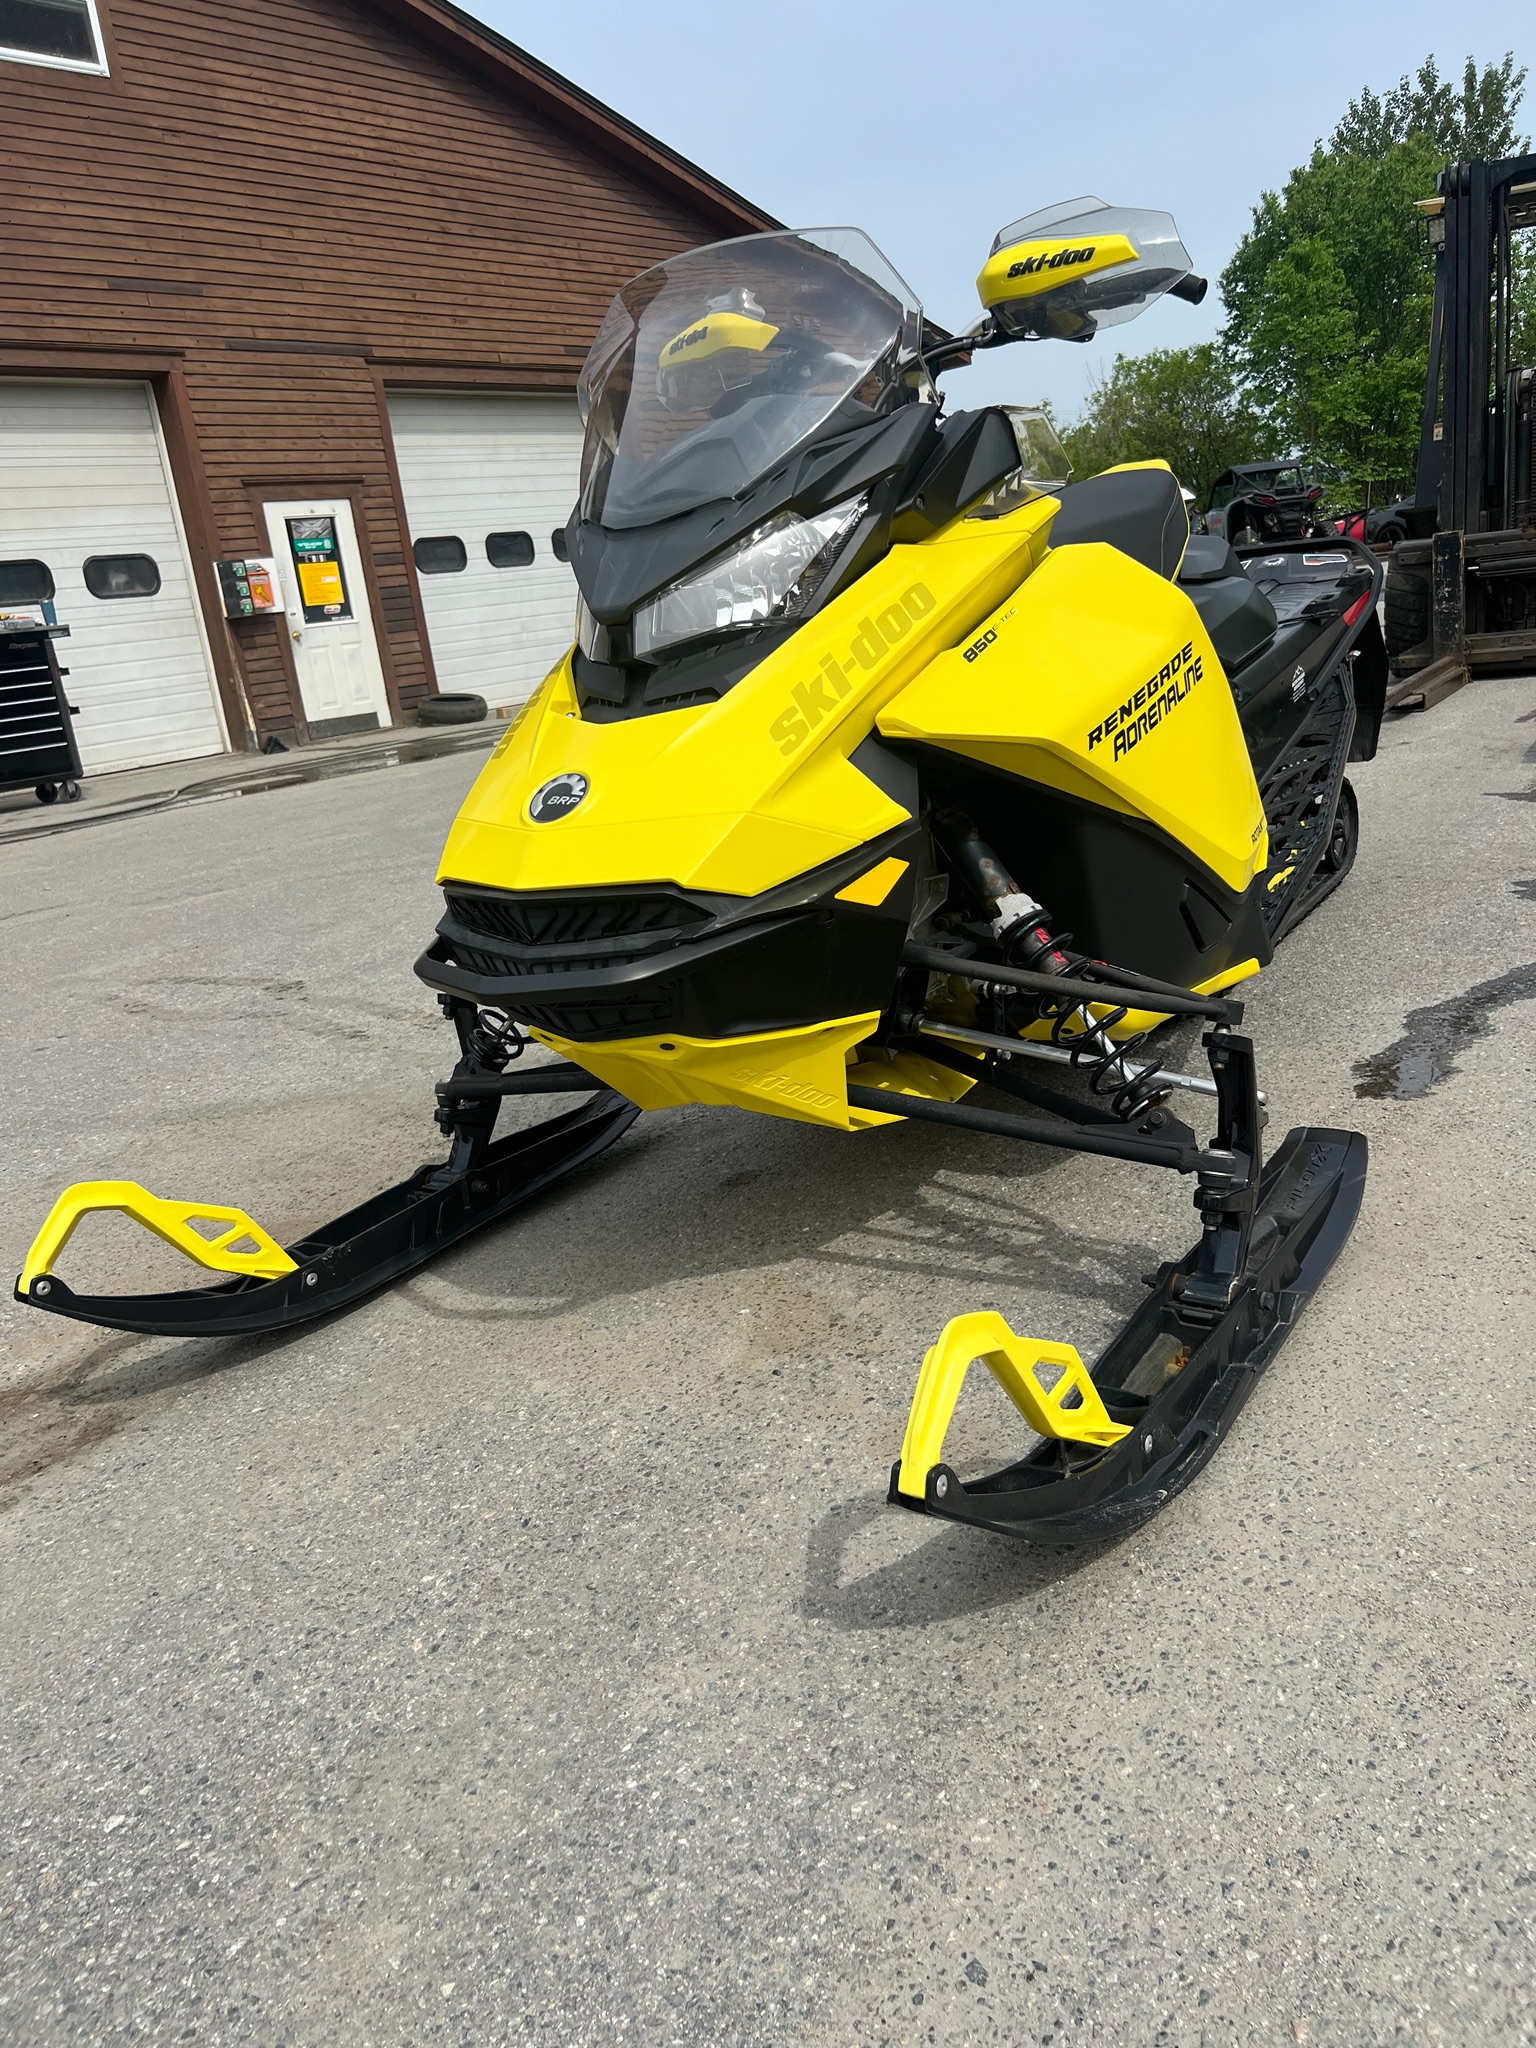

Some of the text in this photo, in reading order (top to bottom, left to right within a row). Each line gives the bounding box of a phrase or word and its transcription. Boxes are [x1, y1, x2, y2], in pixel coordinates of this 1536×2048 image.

[1007, 246, 1096, 279] ski-doo
[962, 606, 1017, 664] 850 E-TEC
[769, 582, 937, 757] ski-doo
[1088, 641, 1193, 751] RENEGADE
[1114, 655, 1203, 763] ADRENALINE
[547, 796, 580, 806] BRP
[728, 1066, 840, 1109] ski-doo
